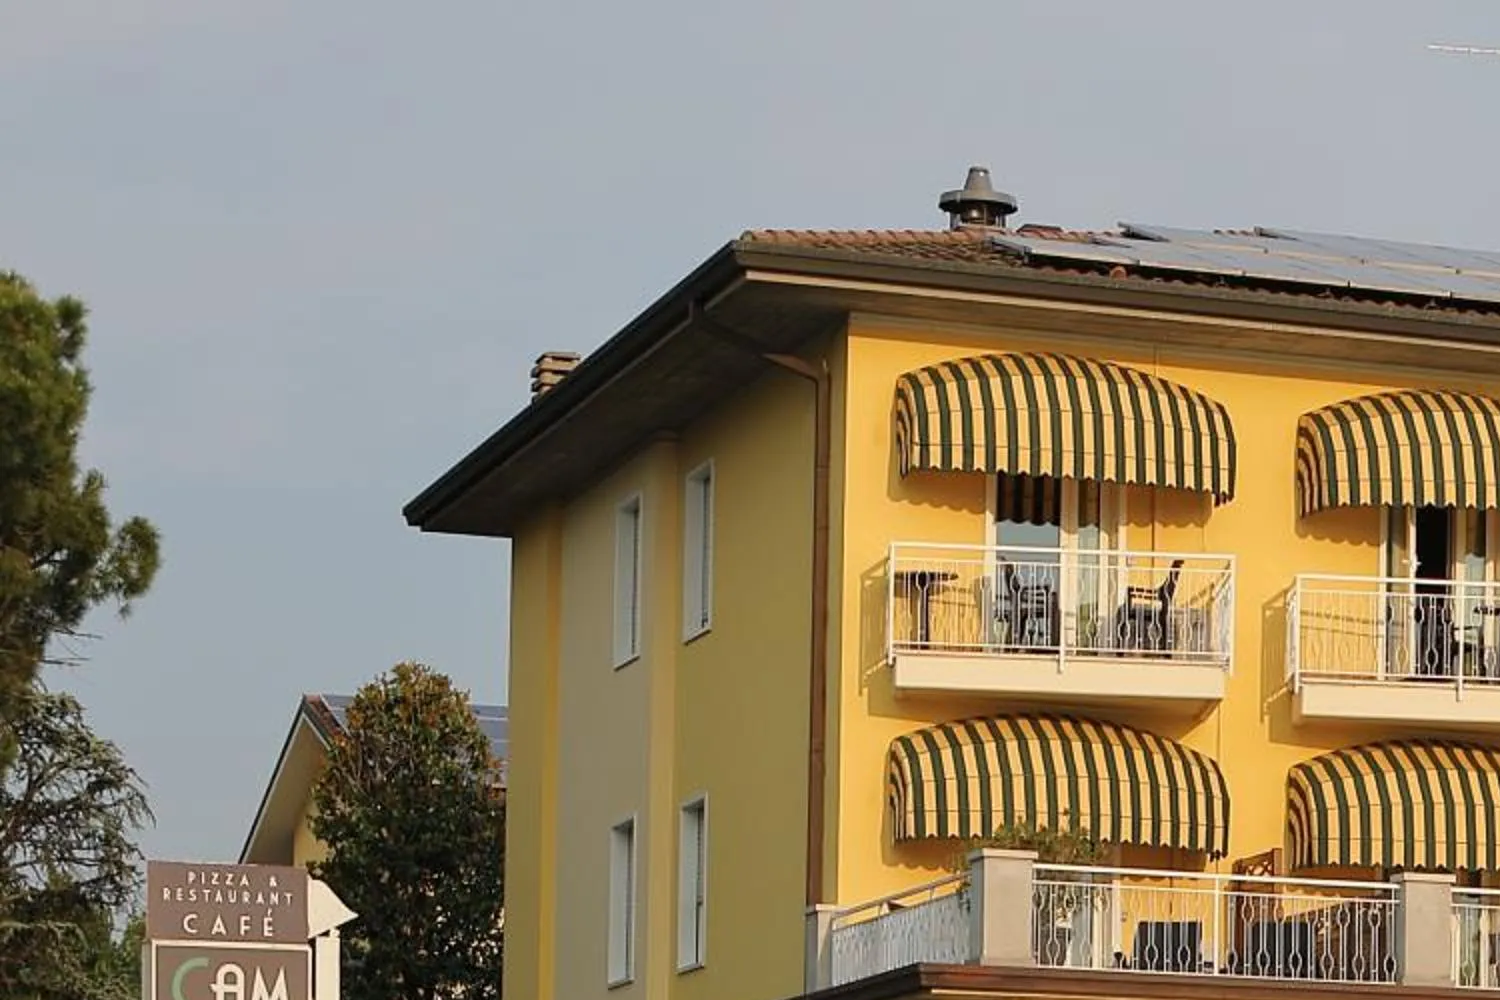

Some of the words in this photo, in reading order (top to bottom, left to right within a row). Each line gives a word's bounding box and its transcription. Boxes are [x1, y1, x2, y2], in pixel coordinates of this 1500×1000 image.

[187, 871, 250, 886] PIZZA
[269, 875, 278, 887] &
[162, 887, 293, 905] RESTAURANT
[183, 908, 273, 937] CAFÉ
